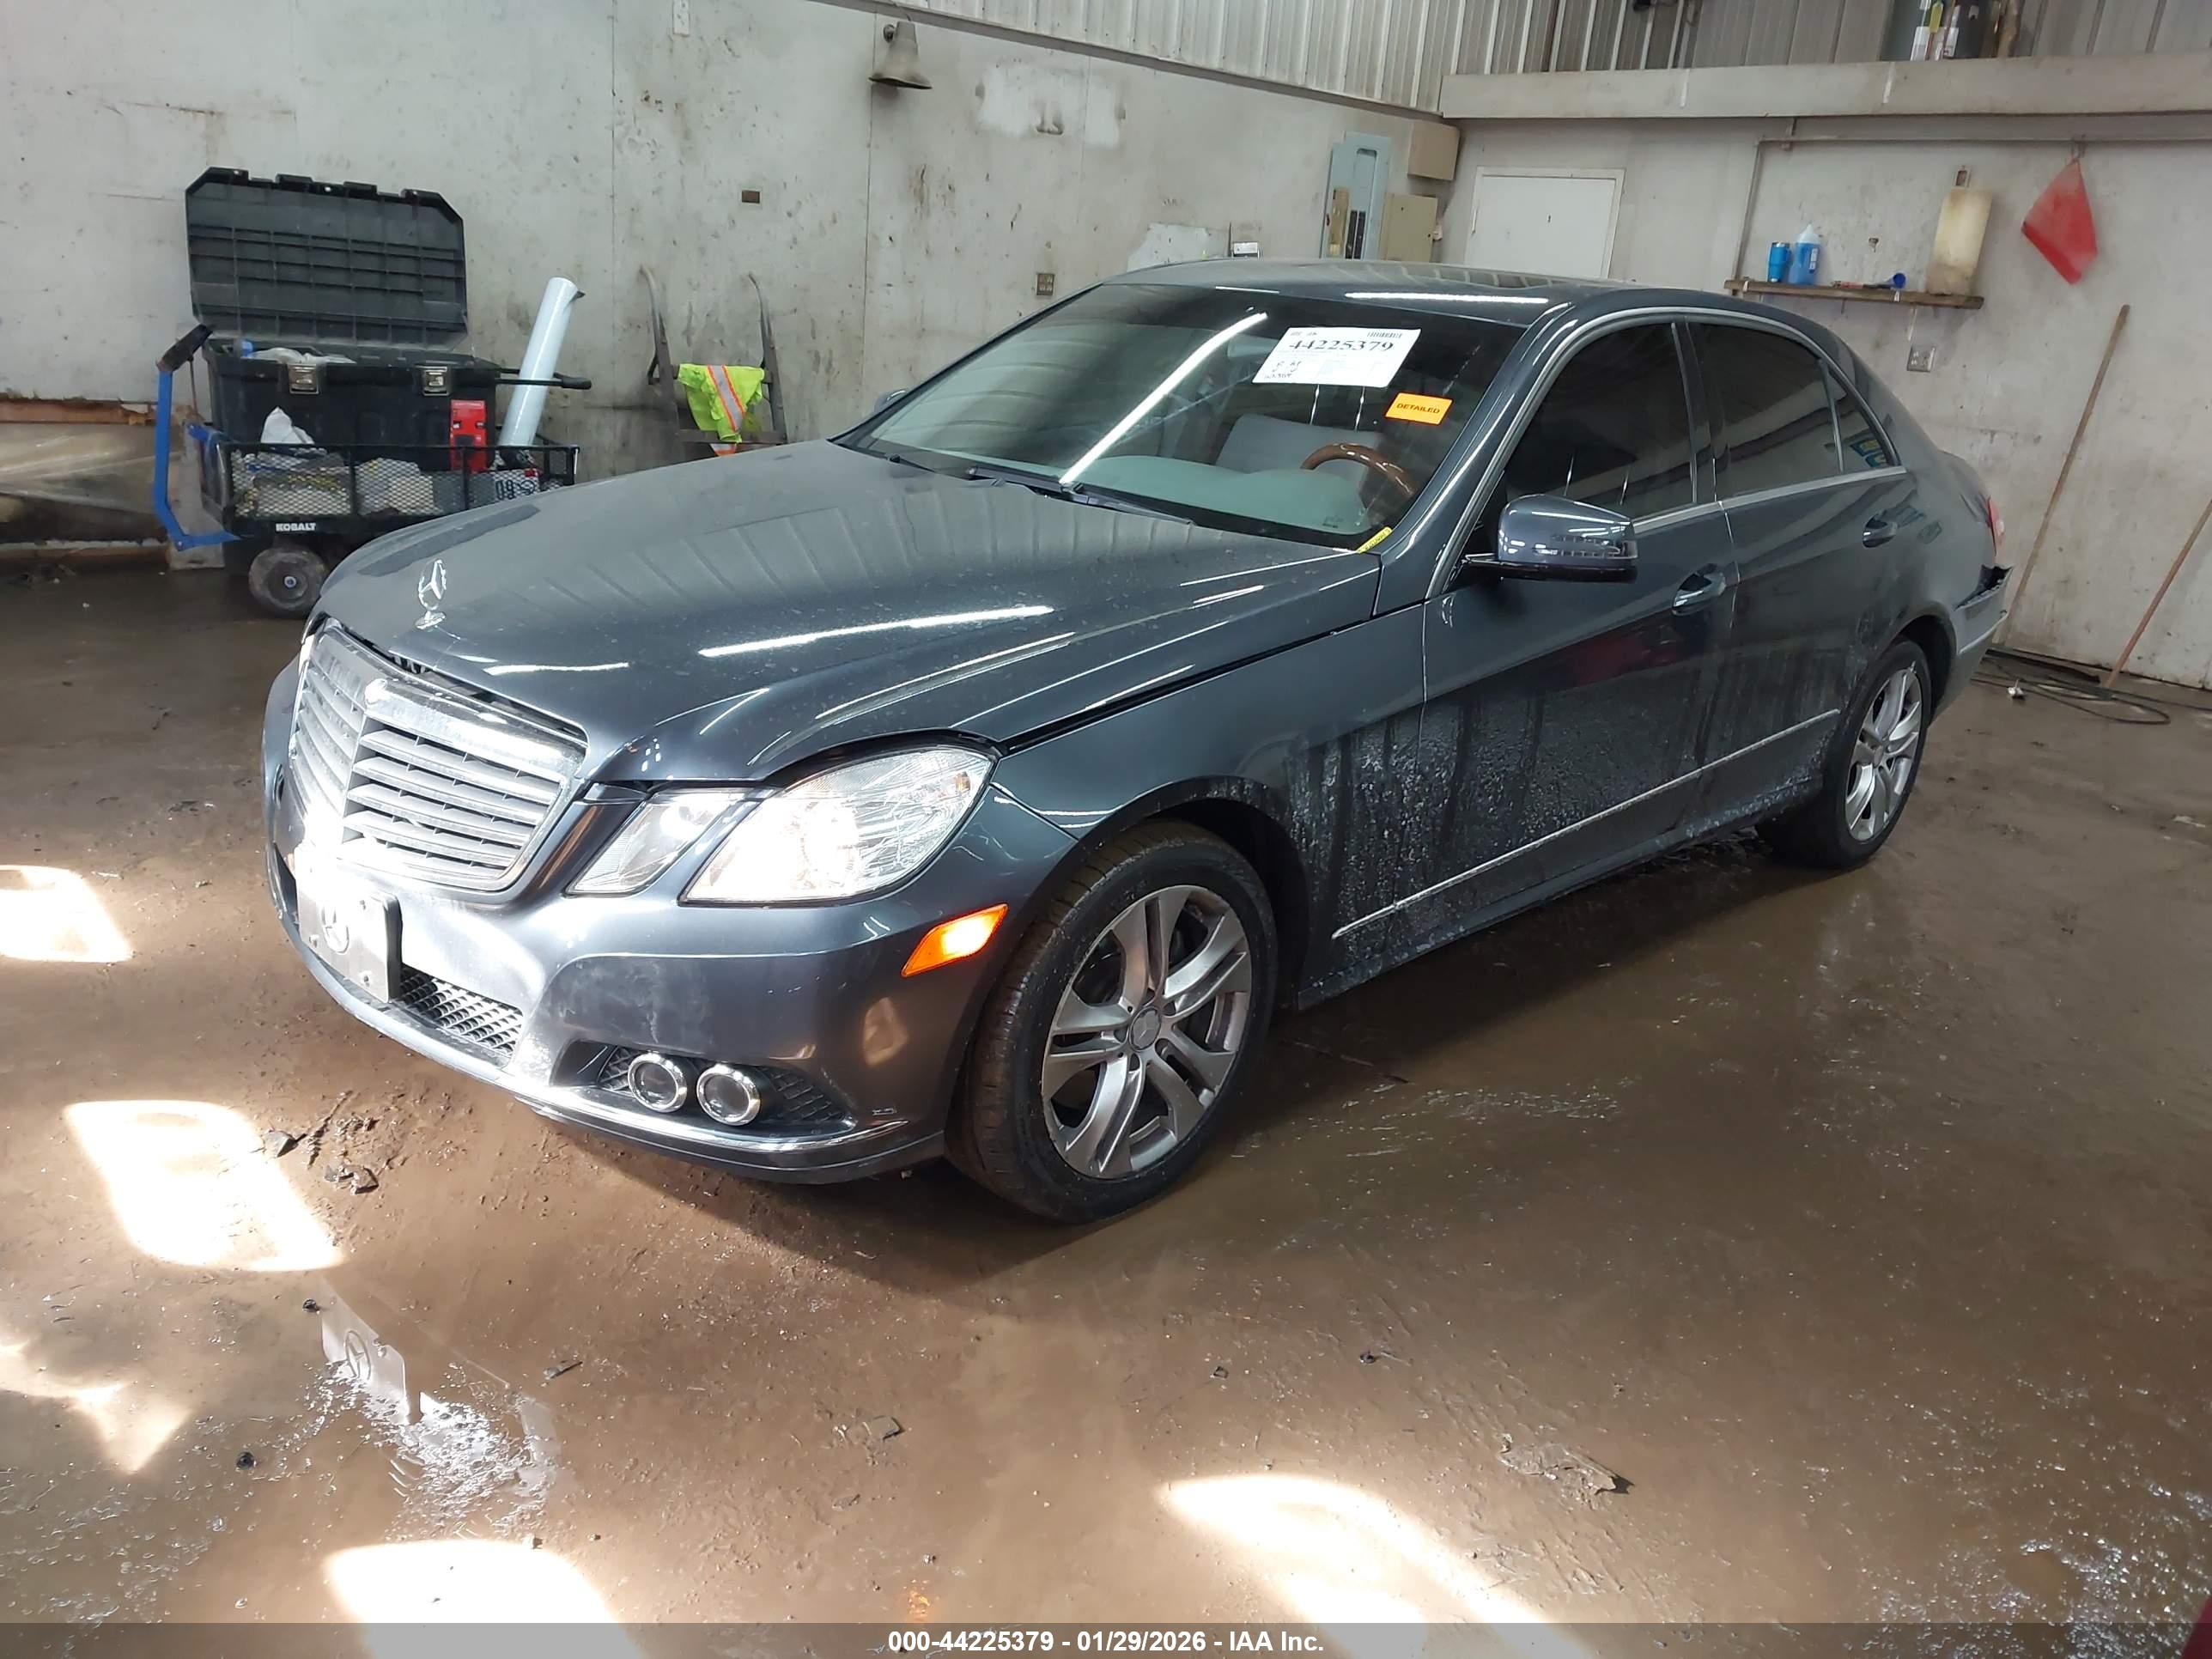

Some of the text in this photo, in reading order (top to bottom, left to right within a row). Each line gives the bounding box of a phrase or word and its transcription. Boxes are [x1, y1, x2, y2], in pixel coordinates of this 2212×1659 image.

[1289, 340, 1394, 351] 44225379
[1396, 403, 1440, 414] DETAILED
[275, 521, 317, 532] KOBALT
